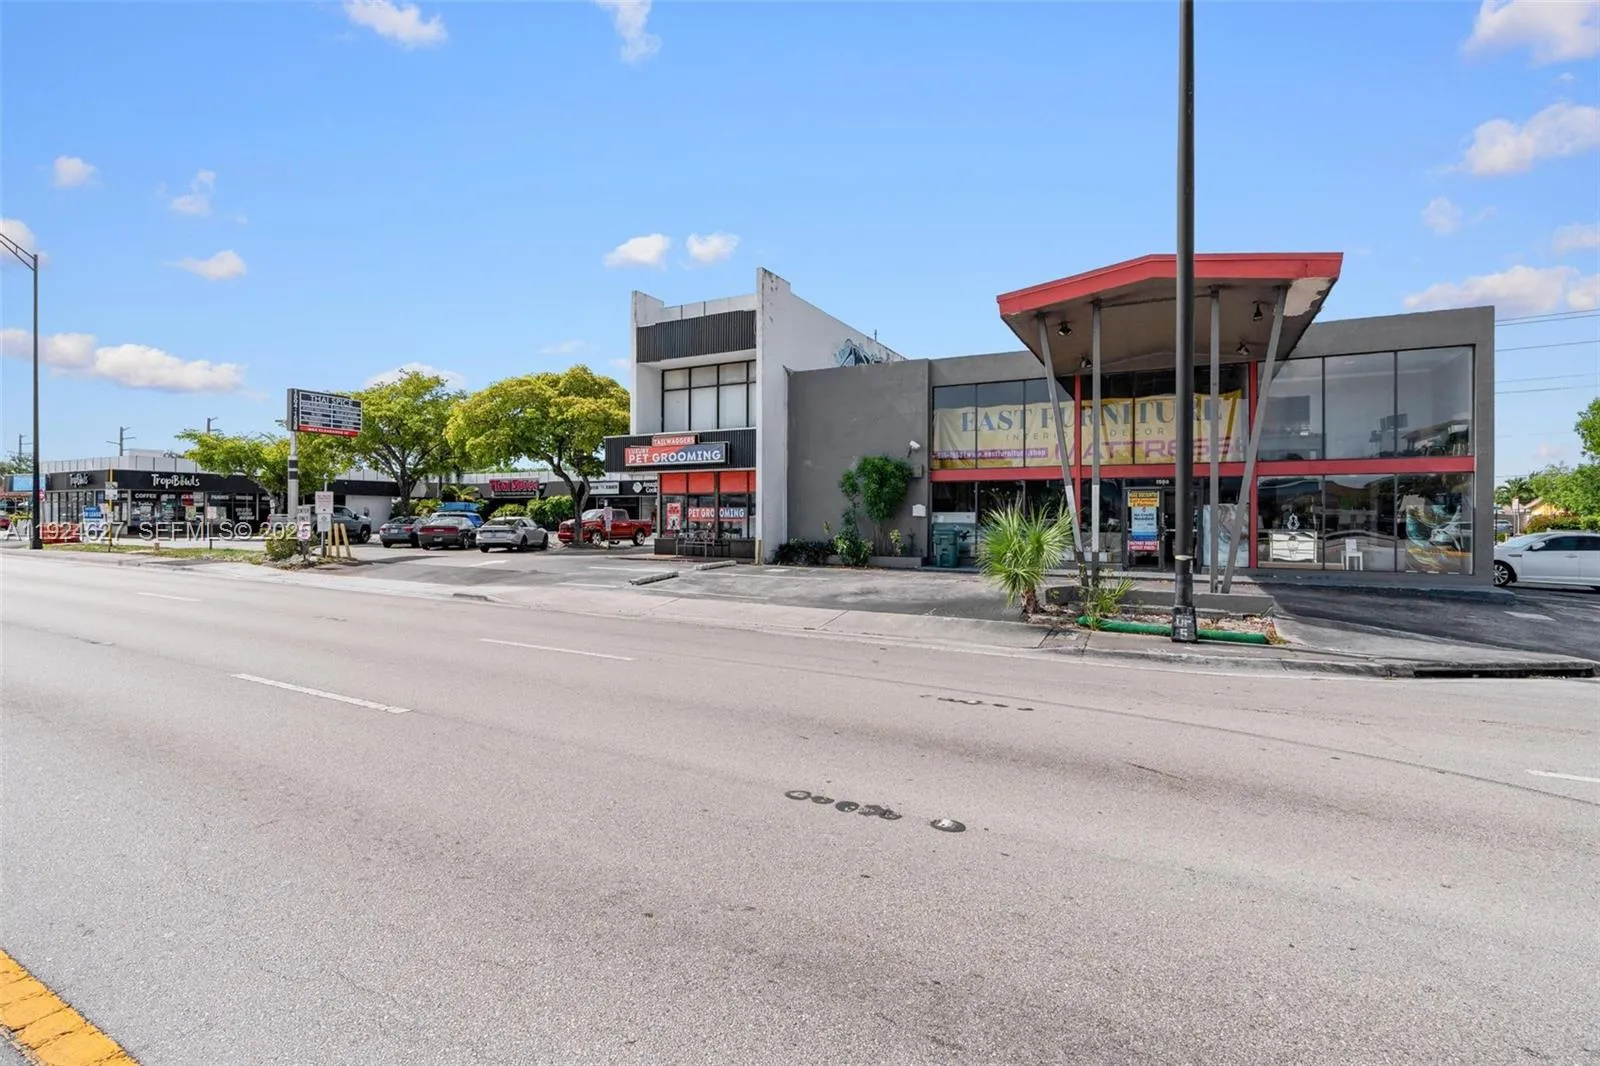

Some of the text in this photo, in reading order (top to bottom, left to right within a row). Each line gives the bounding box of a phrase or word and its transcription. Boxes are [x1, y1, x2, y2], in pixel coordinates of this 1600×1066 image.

[311, 395, 353, 406] THAI SPICE
[961, 408, 1033, 432] EAST
[653, 437, 695, 446] TAILWAGGERS
[628, 450, 721, 464] PET GROOMING
[151, 473, 200, 489] TropiBowls
[688, 508, 700, 518] PET
